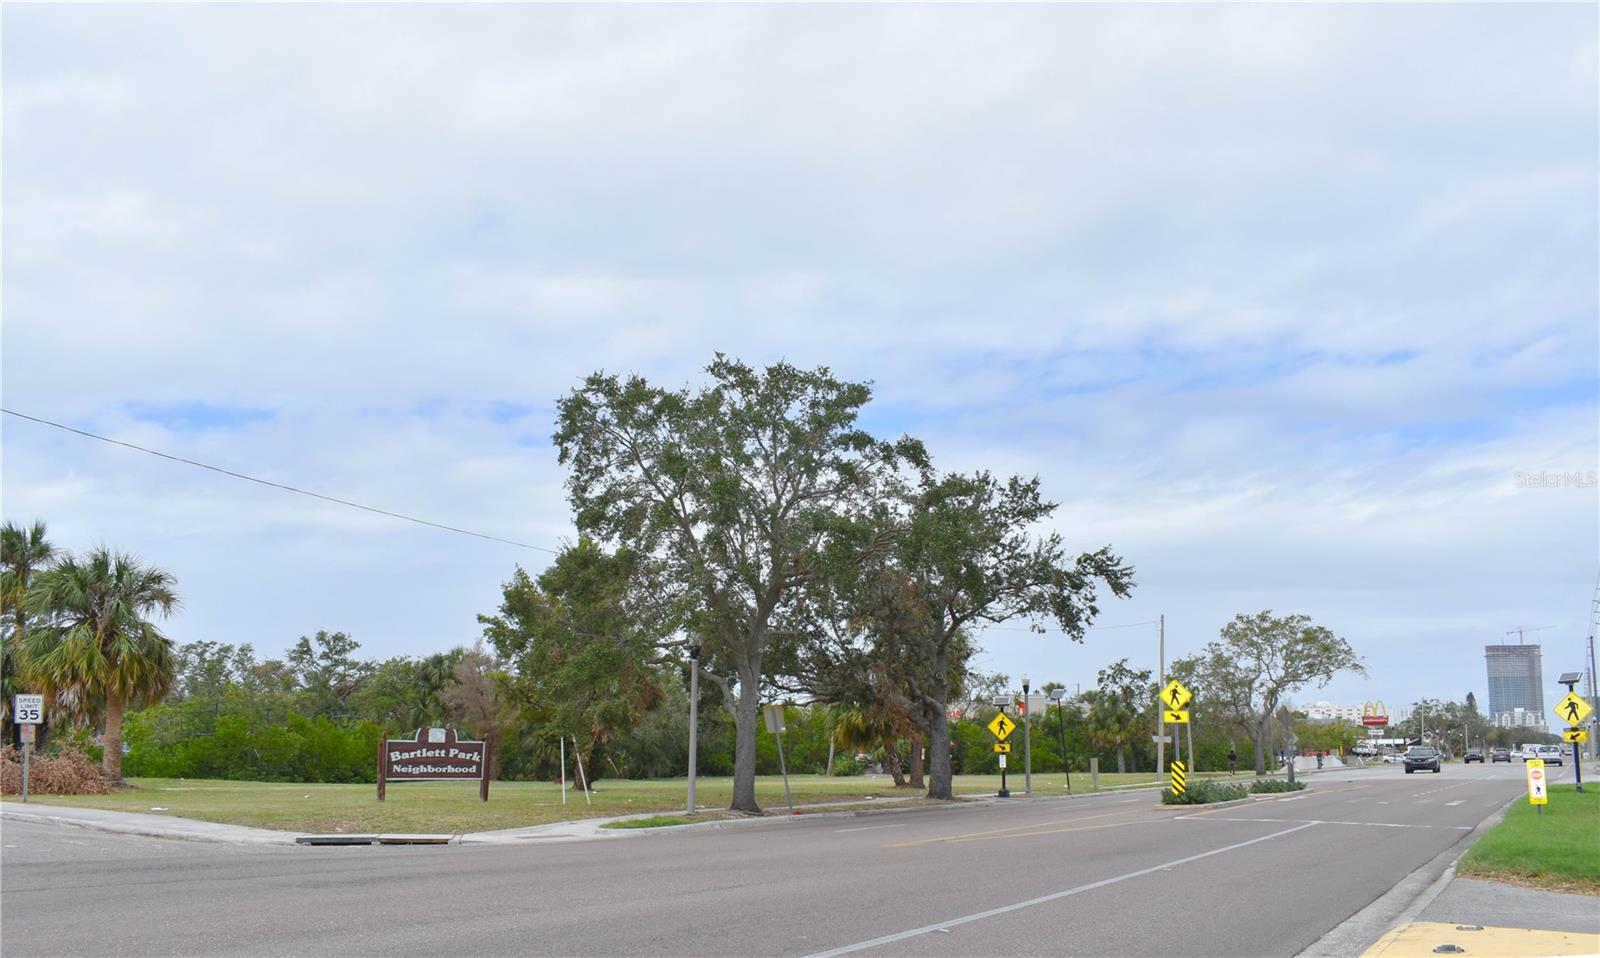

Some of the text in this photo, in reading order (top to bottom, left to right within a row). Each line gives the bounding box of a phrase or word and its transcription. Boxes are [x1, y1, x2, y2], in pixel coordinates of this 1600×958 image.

[18, 709, 39, 720] 35
[390, 748, 481, 762] Bartlett Park
[392, 764, 477, 775] Neighborhood
